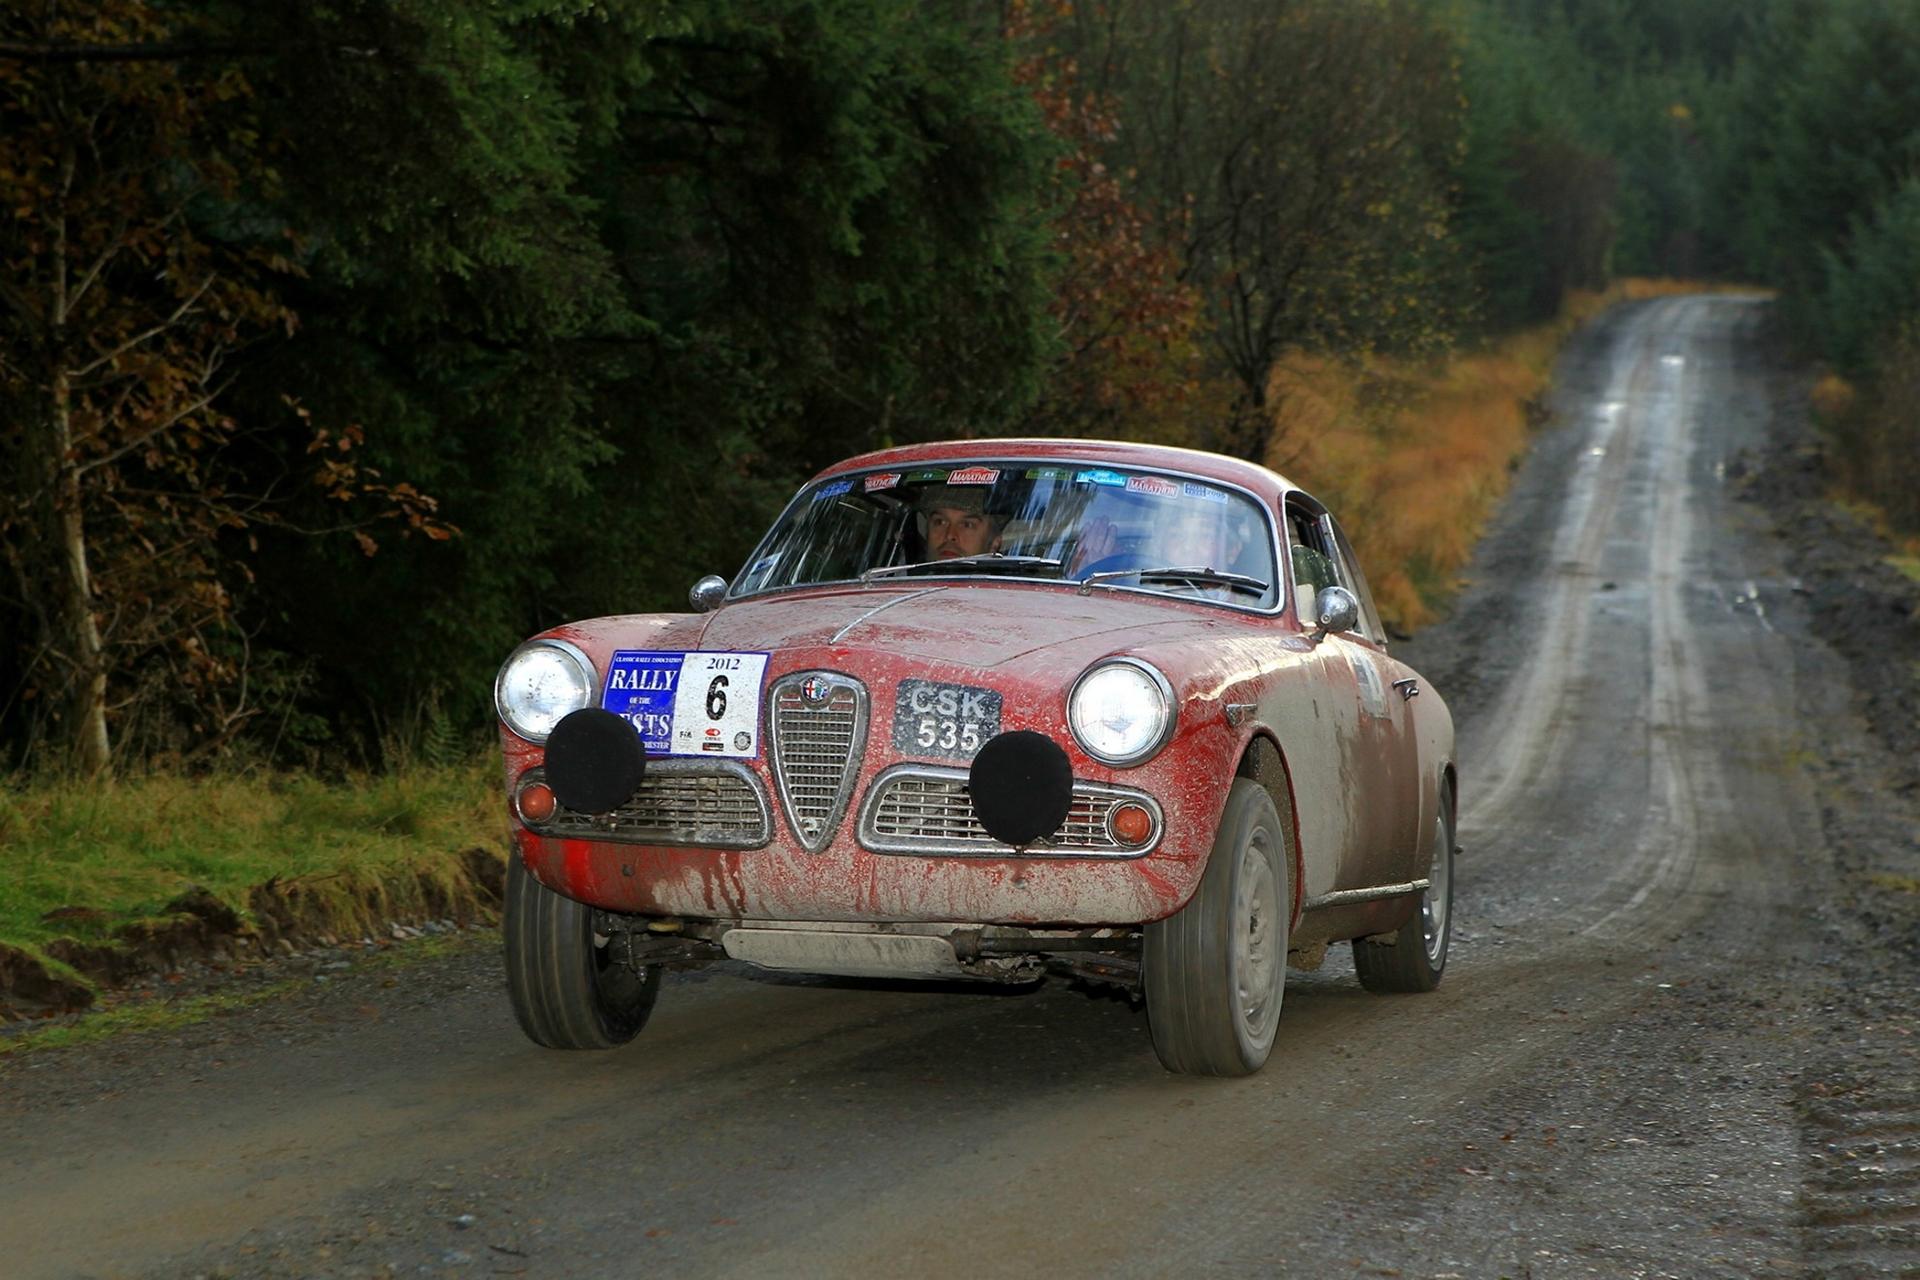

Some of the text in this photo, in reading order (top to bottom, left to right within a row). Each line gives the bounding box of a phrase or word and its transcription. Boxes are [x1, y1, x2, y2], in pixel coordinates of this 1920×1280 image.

[952, 471, 995, 482] MARATHON
[1130, 479, 1176, 496] MARATHON
[706, 658, 741, 670] 2012
[609, 669, 678, 691] RALLY
[705, 674, 729, 721] 6
[911, 687, 985, 719] CSK
[618, 713, 670, 737] STS
[917, 720, 979, 751] 535
